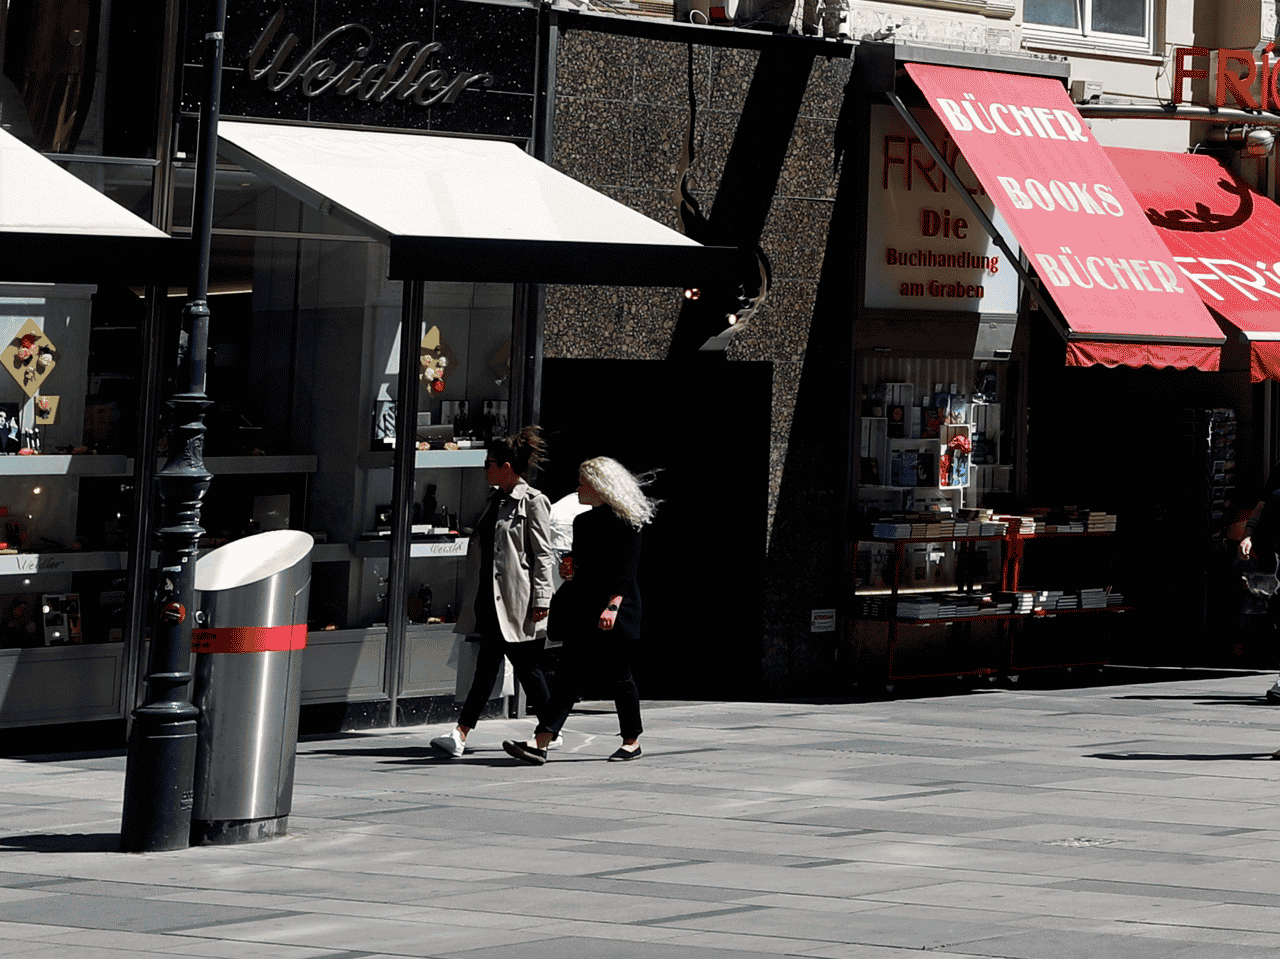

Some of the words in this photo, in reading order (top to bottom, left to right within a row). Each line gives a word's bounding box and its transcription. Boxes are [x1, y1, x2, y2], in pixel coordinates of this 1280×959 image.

[936, 93, 1088, 142] BÜCHER
[997, 176, 1124, 217] BOOKS
[921, 208, 968, 239] Die
[886, 247, 999, 273] Buchhandlung
[1035, 247, 1184, 293] BÜCHER
[900, 283, 924, 297] am
[927, 280, 984, 298] Graben
